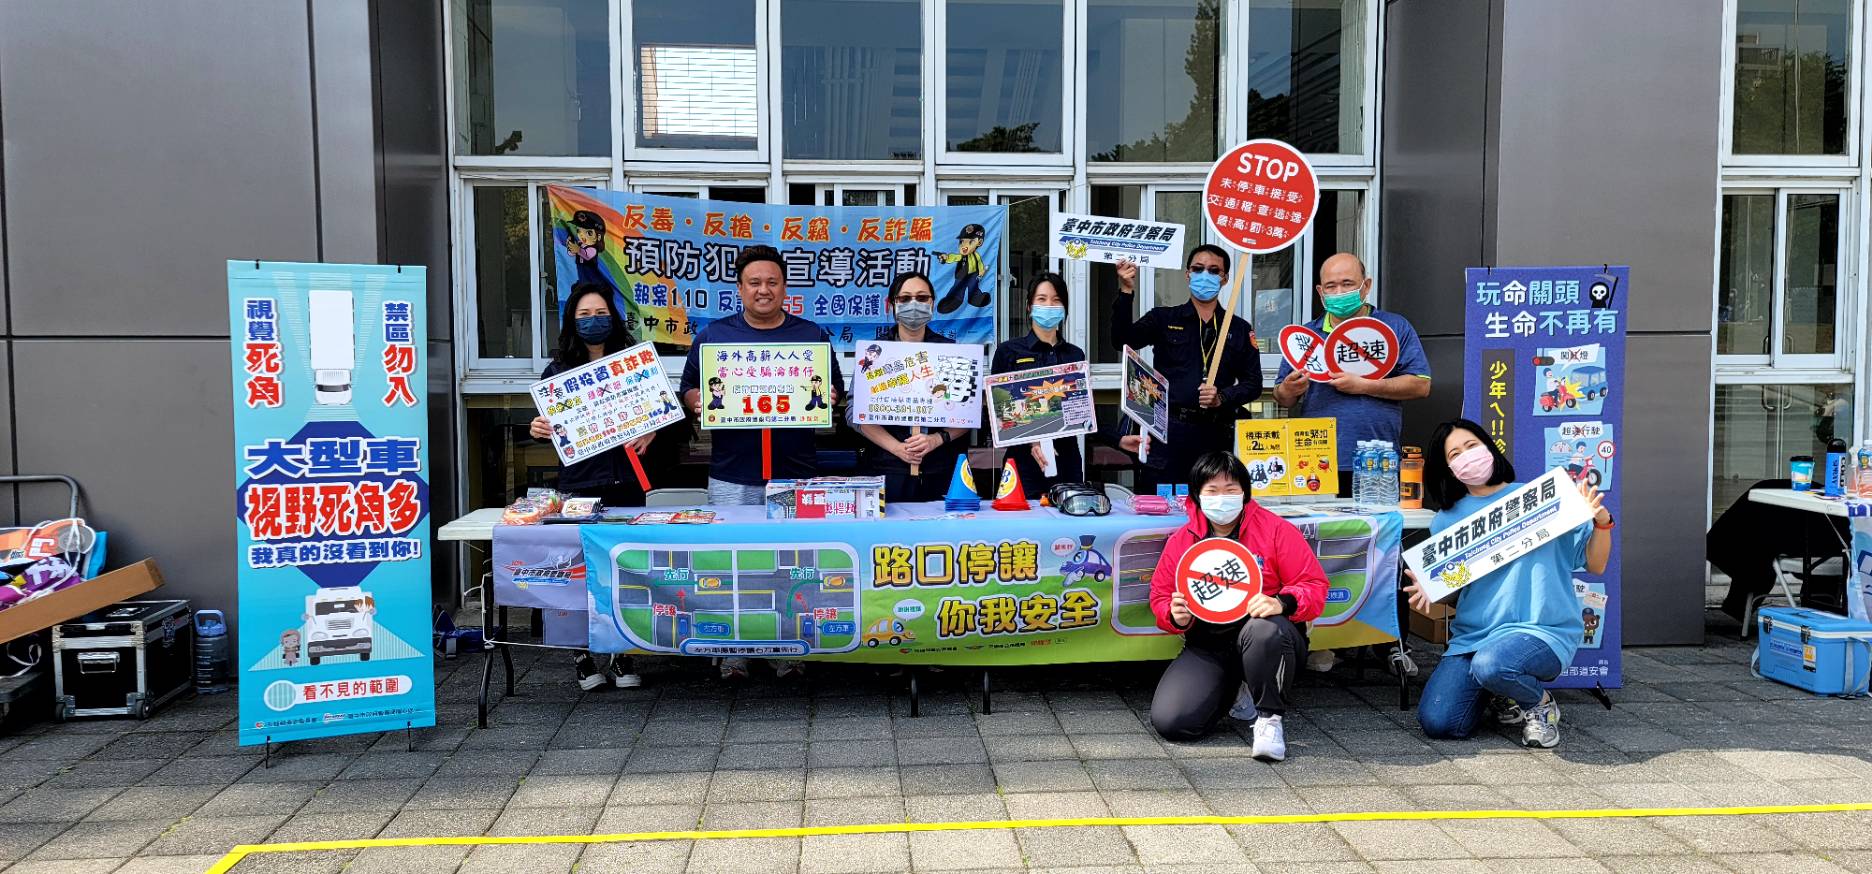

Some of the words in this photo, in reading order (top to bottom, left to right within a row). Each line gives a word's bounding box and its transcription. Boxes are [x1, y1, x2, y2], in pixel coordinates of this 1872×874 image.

[1237, 152, 1299, 182] STOP
[1060, 218, 1177, 241] 臺中市政府警察局
[624, 237, 930, 287] 預防犯宣導活動
[634, 283, 707, 309] 報案110
[814, 294, 881, 316] 全國保護
[1476, 280, 1581, 306] 玩命關頭
[1485, 307, 1619, 338] 生命不再有
[246, 299, 281, 406] 視覺死角
[383, 302, 416, 405] 禁區勿入
[716, 349, 814, 362] 海外高薪人人愛
[1337, 340, 1386, 364] 超速
[741, 395, 791, 415] 165
[247, 438, 419, 477] 大型車
[1601, 445, 1612, 454] 40
[247, 483, 418, 538] 視野死角多
[1422, 477, 1556, 569] 臺中市政府警察局
[251, 541, 419, 565] 我真的沒看到你!
[1490, 528, 1550, 565] 第二分局
[664, 567, 689, 581] 先行
[789, 566, 815, 580] 先行
[873, 540, 1038, 588] 路口停讓
[1190, 558, 1248, 605] 超速
[653, 603, 677, 617] 停讓
[813, 608, 838, 621] 停讓
[939, 592, 1099, 637] 你我安全
[303, 678, 399, 701] 看不見的範圍
